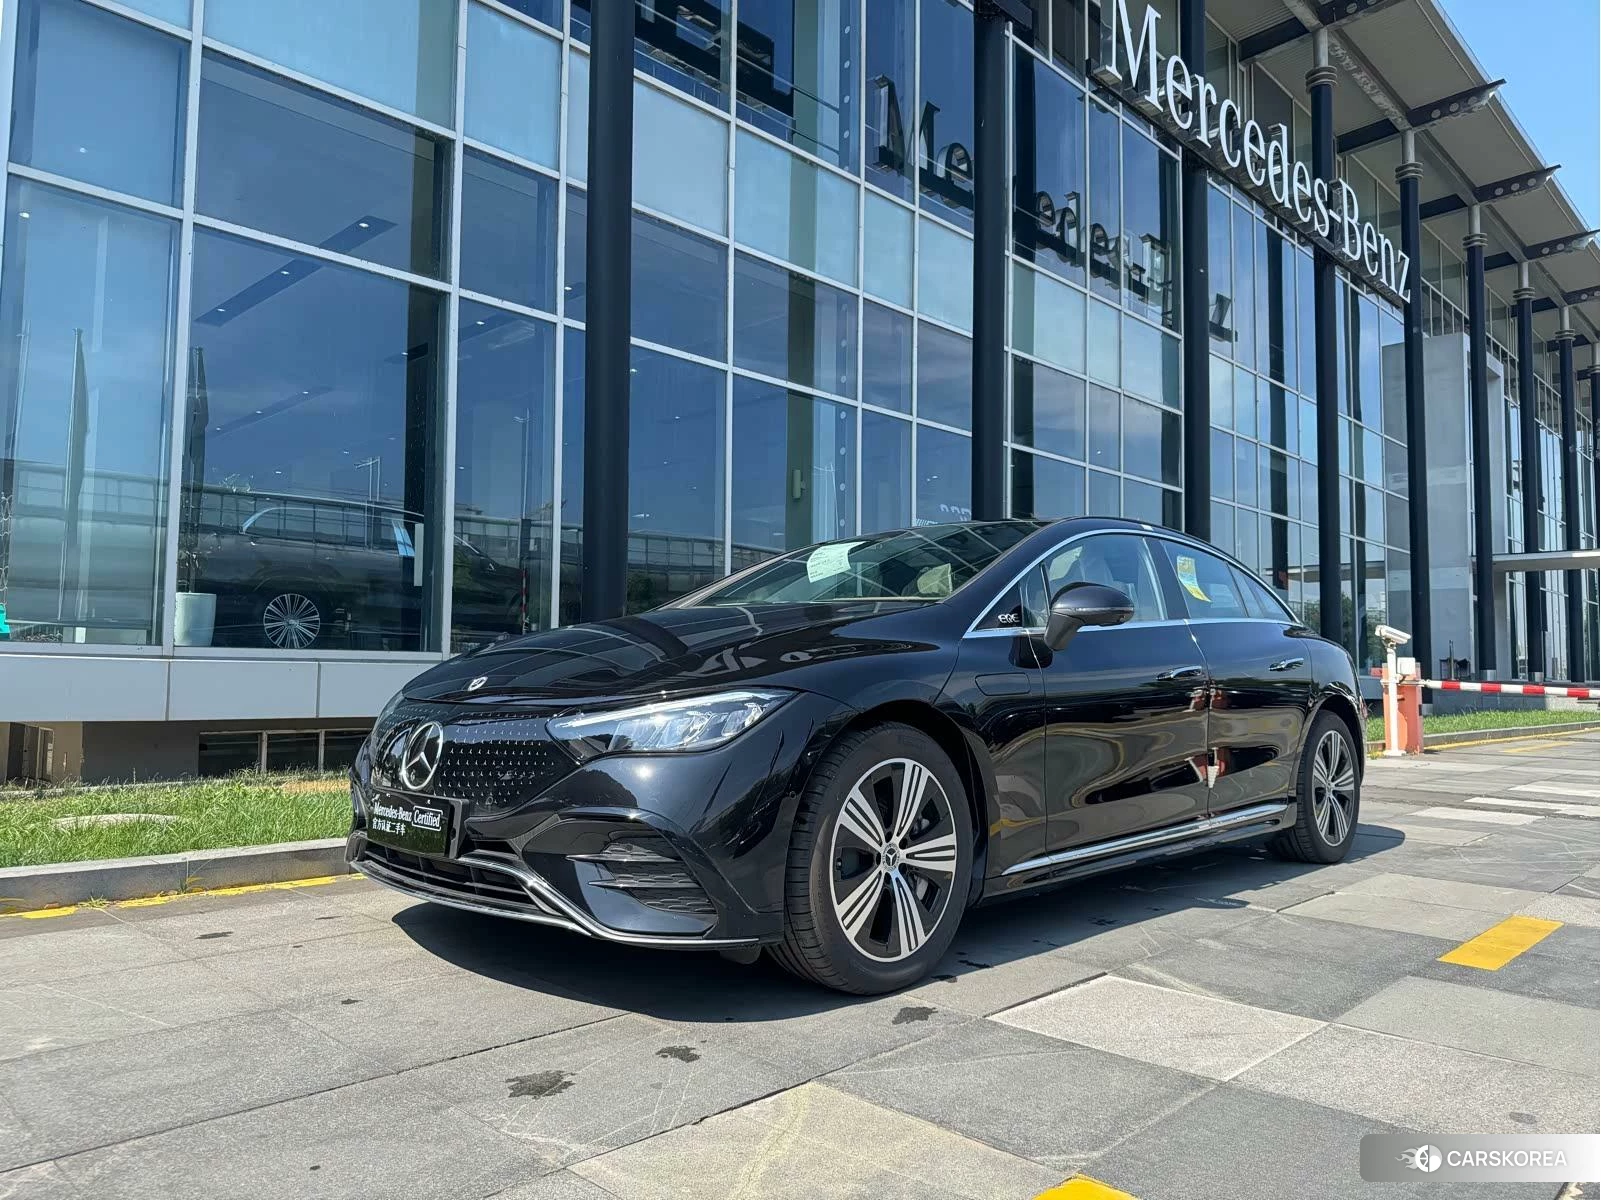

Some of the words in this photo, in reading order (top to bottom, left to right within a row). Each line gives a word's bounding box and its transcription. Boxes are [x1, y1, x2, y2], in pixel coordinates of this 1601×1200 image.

[1104, 0, 1411, 304] Mercedes-Benz
[998, 613, 1020, 623] EQE
[374, 801, 412, 822] Mercedes-Benz
[414, 810, 441, 827] Certified
[372, 817, 406, 836] 官方认证二手车
